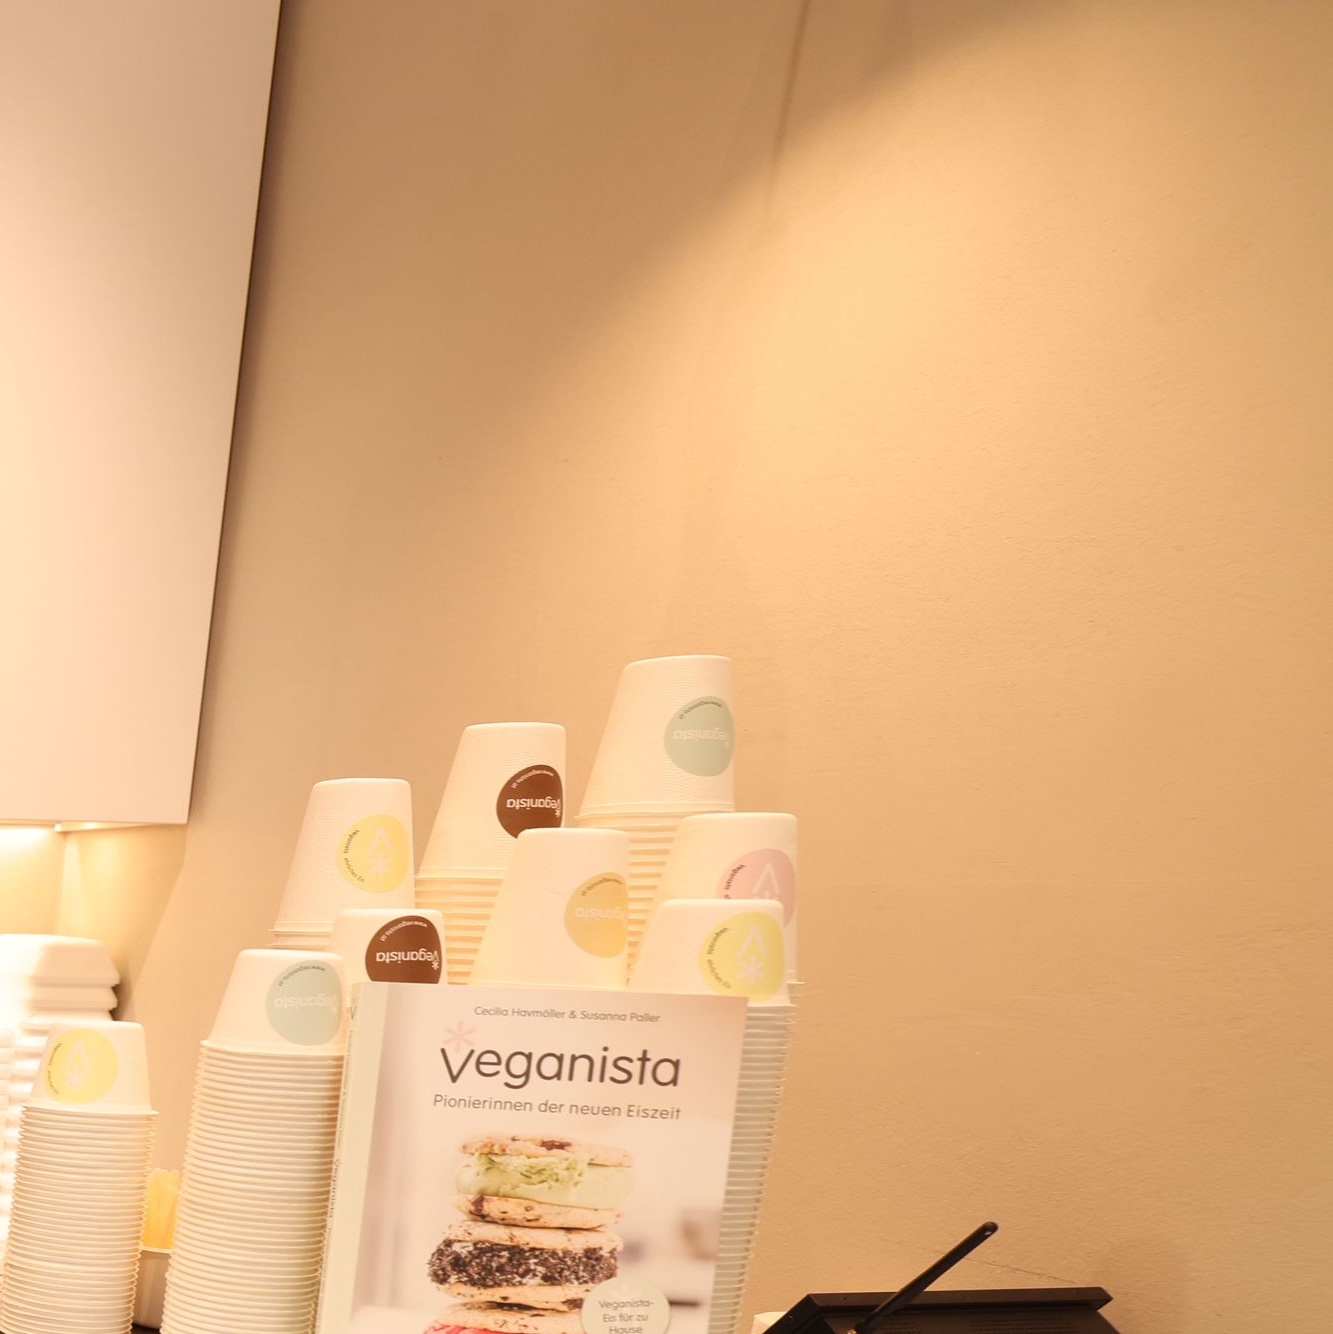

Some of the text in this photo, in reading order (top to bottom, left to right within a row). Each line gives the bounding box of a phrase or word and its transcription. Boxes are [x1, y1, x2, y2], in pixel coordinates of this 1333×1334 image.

[474, 1005, 662, 1024] Cecilia Havmöller & Susanna Paller
[433, 1094, 682, 1121] Pionierinnen der neuen Eiszeit
[598, 1299, 654, 1311] Veganista-
[602, 1312, 649, 1323] Eis für zu
[609, 1325, 644, 1334] Hause
